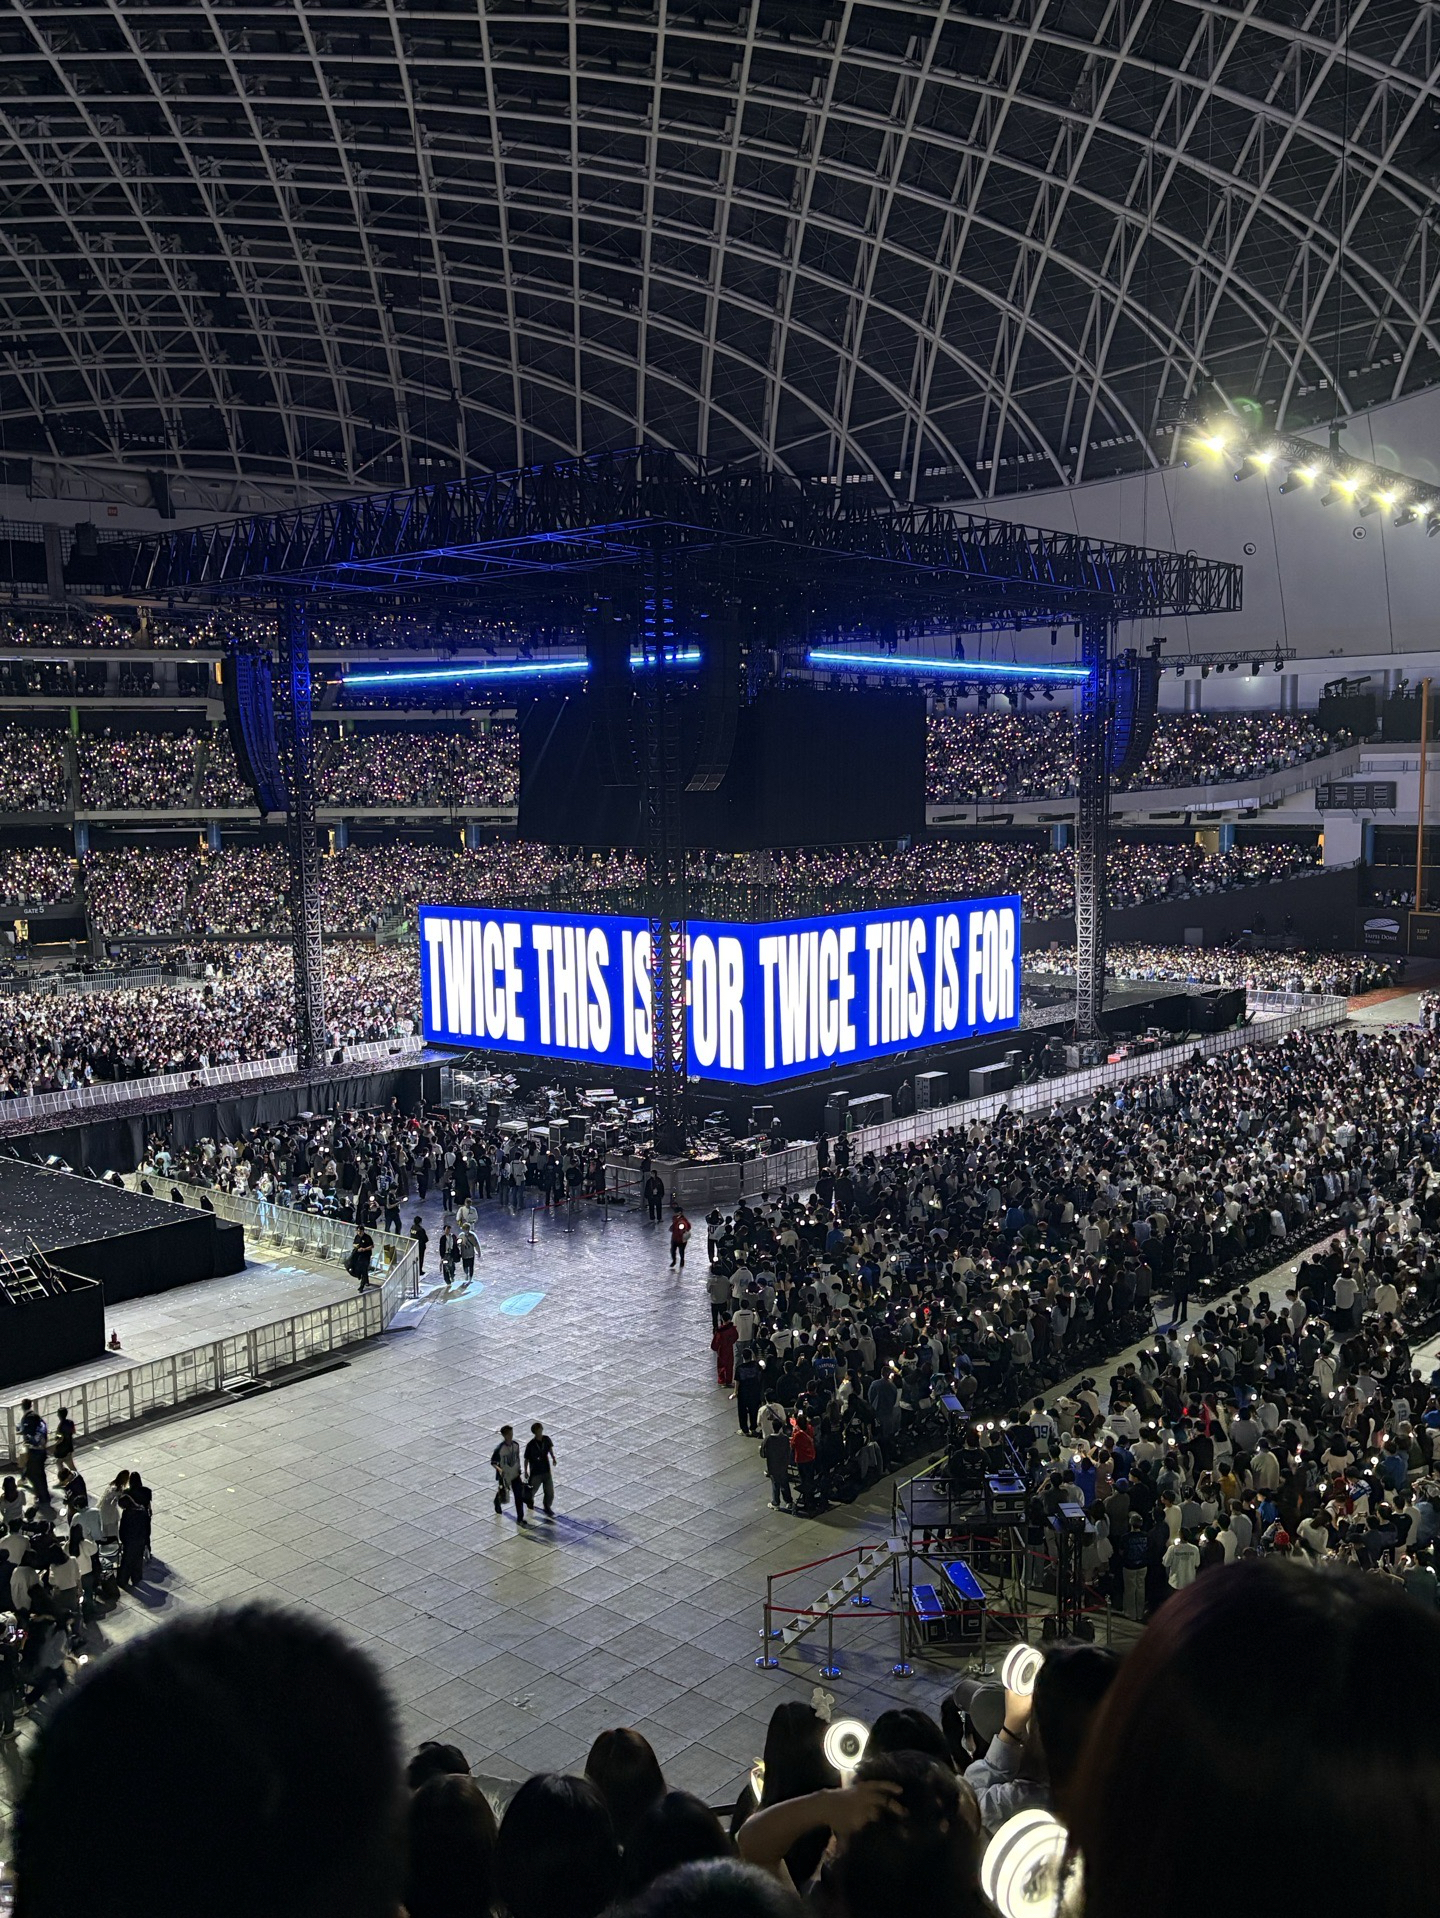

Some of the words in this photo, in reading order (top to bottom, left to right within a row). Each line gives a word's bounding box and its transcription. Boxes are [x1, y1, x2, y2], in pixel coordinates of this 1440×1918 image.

[424, 918, 525, 1042] TWICE
[532, 925, 611, 1053] THIS
[622, 931, 657, 1059] IS
[760, 927, 856, 1070] TWICE
[866, 918, 926, 1047] THIS
[935, 914, 960, 1033] IS
[968, 909, 1015, 1026] FOR
[1033, 1425, 1049, 1438] 09
